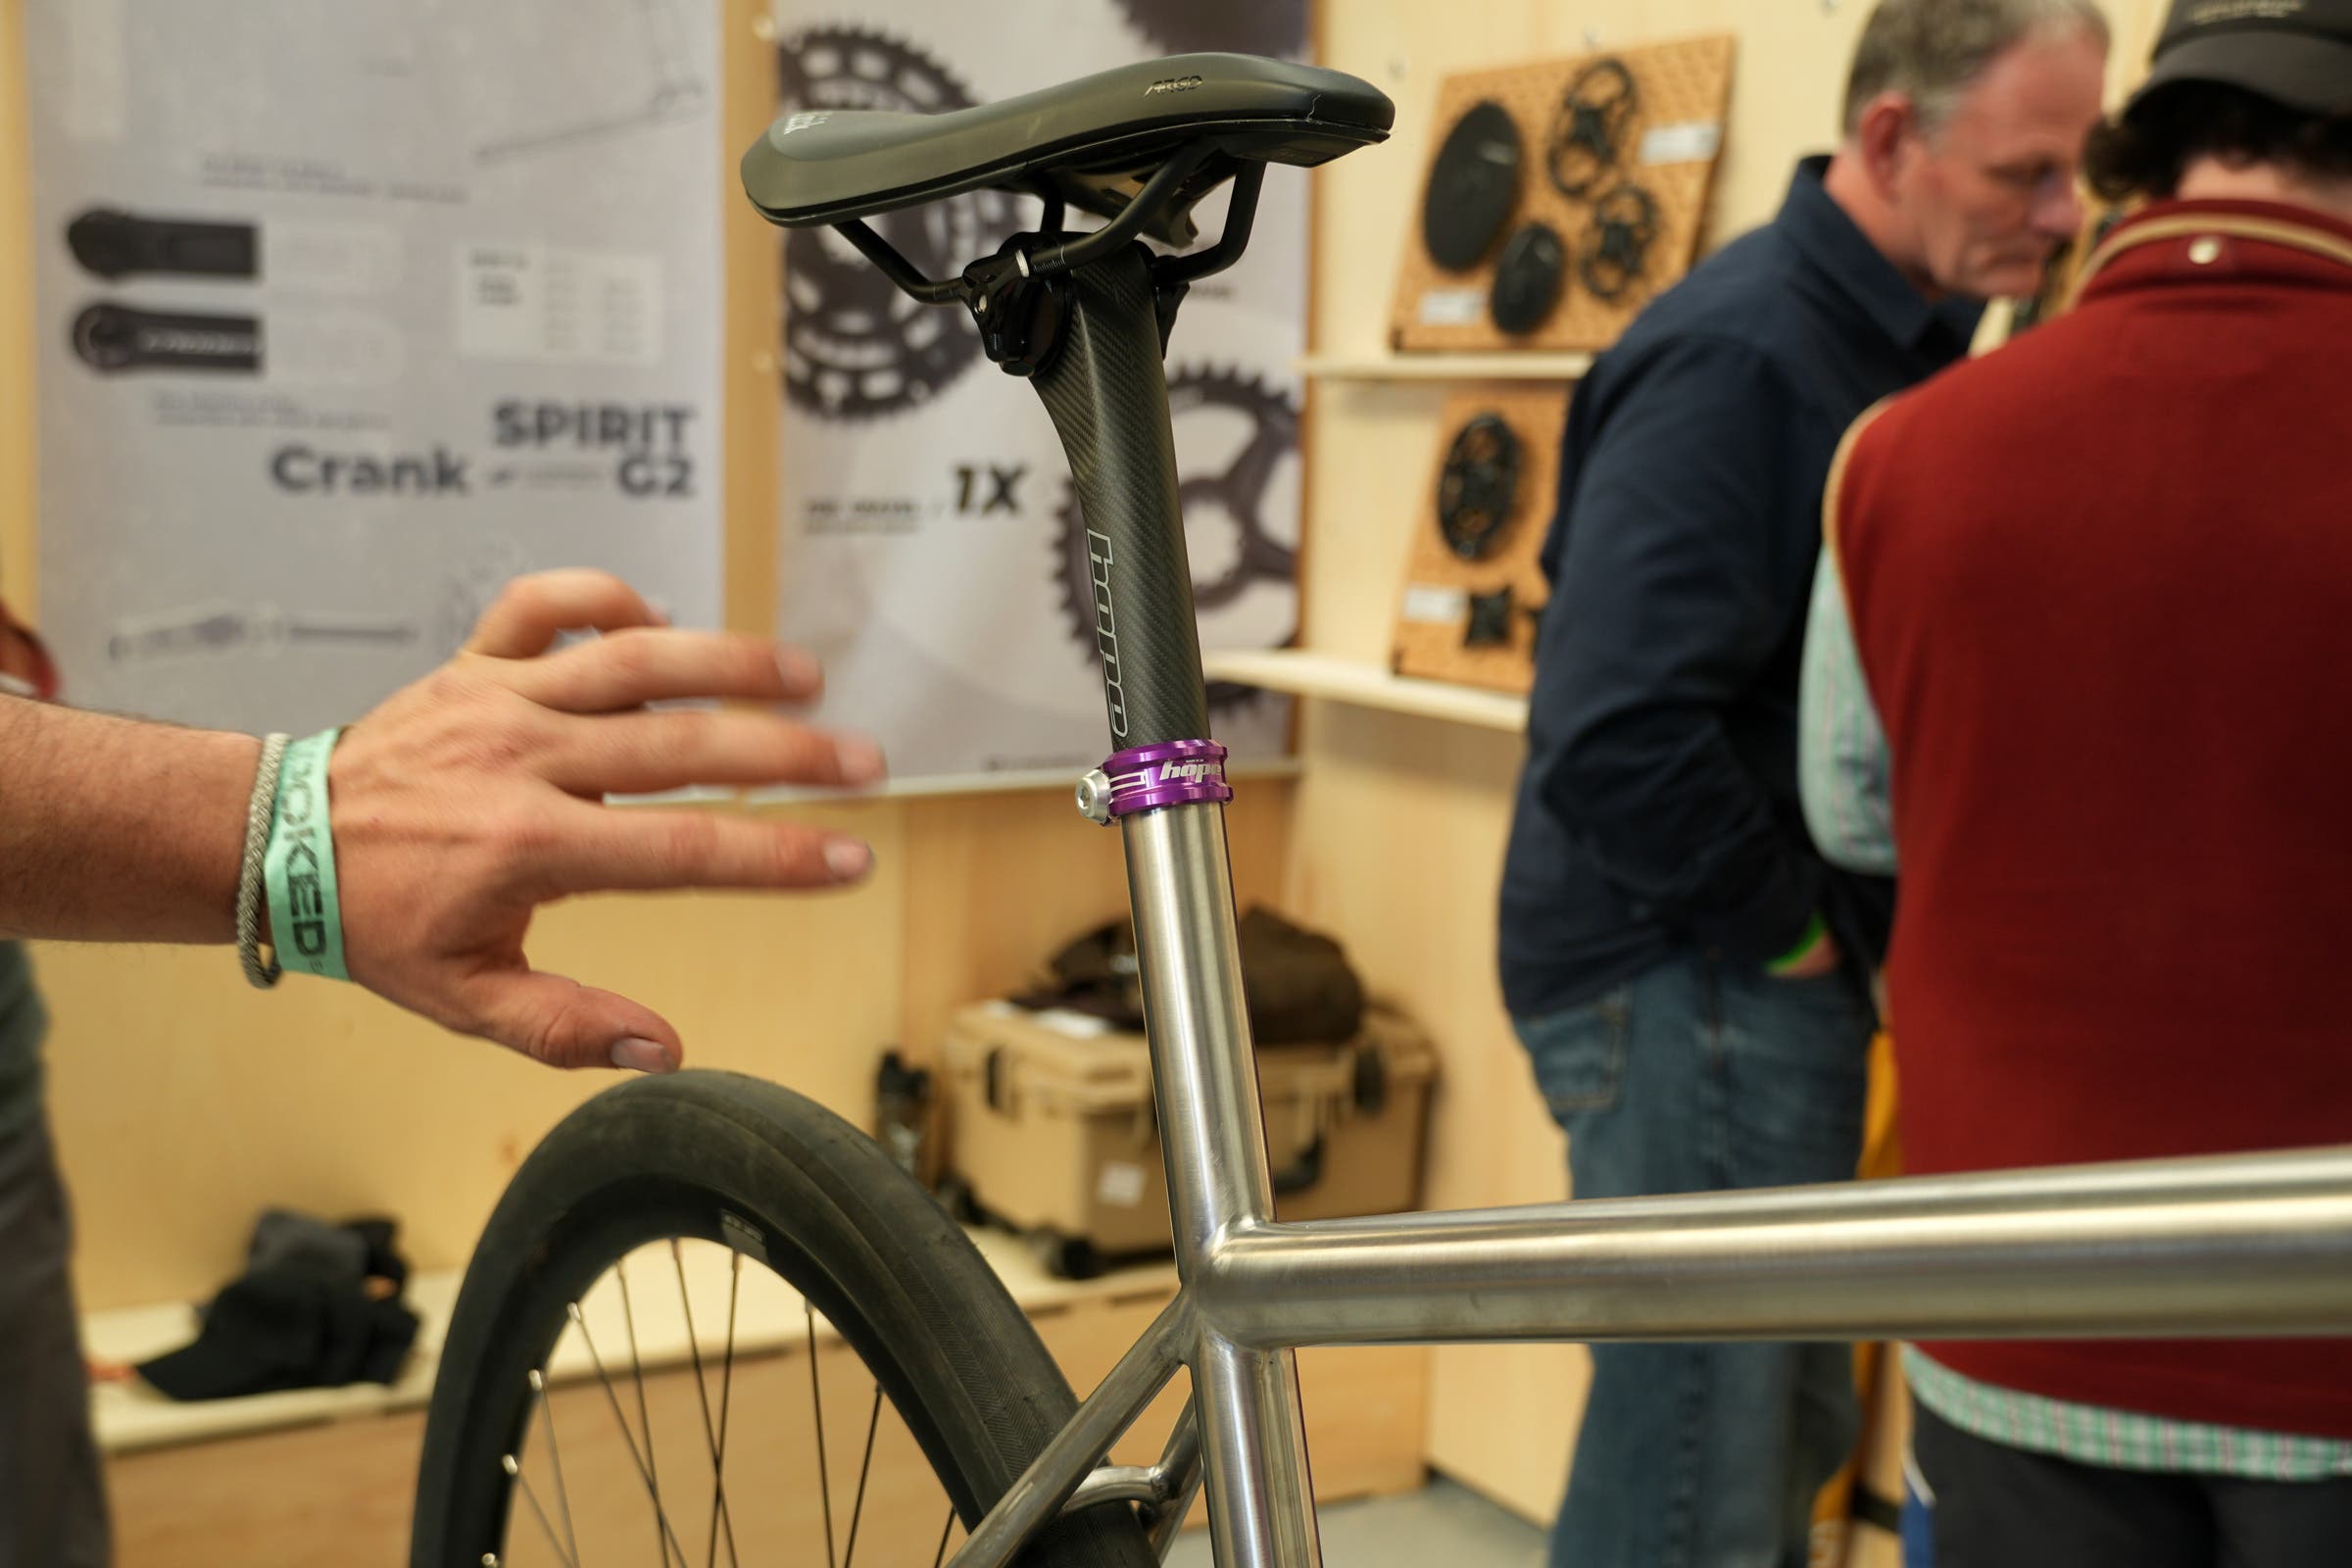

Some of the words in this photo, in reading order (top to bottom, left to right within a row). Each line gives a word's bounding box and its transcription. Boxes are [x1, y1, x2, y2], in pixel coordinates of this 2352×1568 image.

[493, 400, 694, 449] SPIRIT
[270, 443, 470, 494] Crank
[616, 453, 695, 496] G2
[954, 465, 1030, 515] 1X
